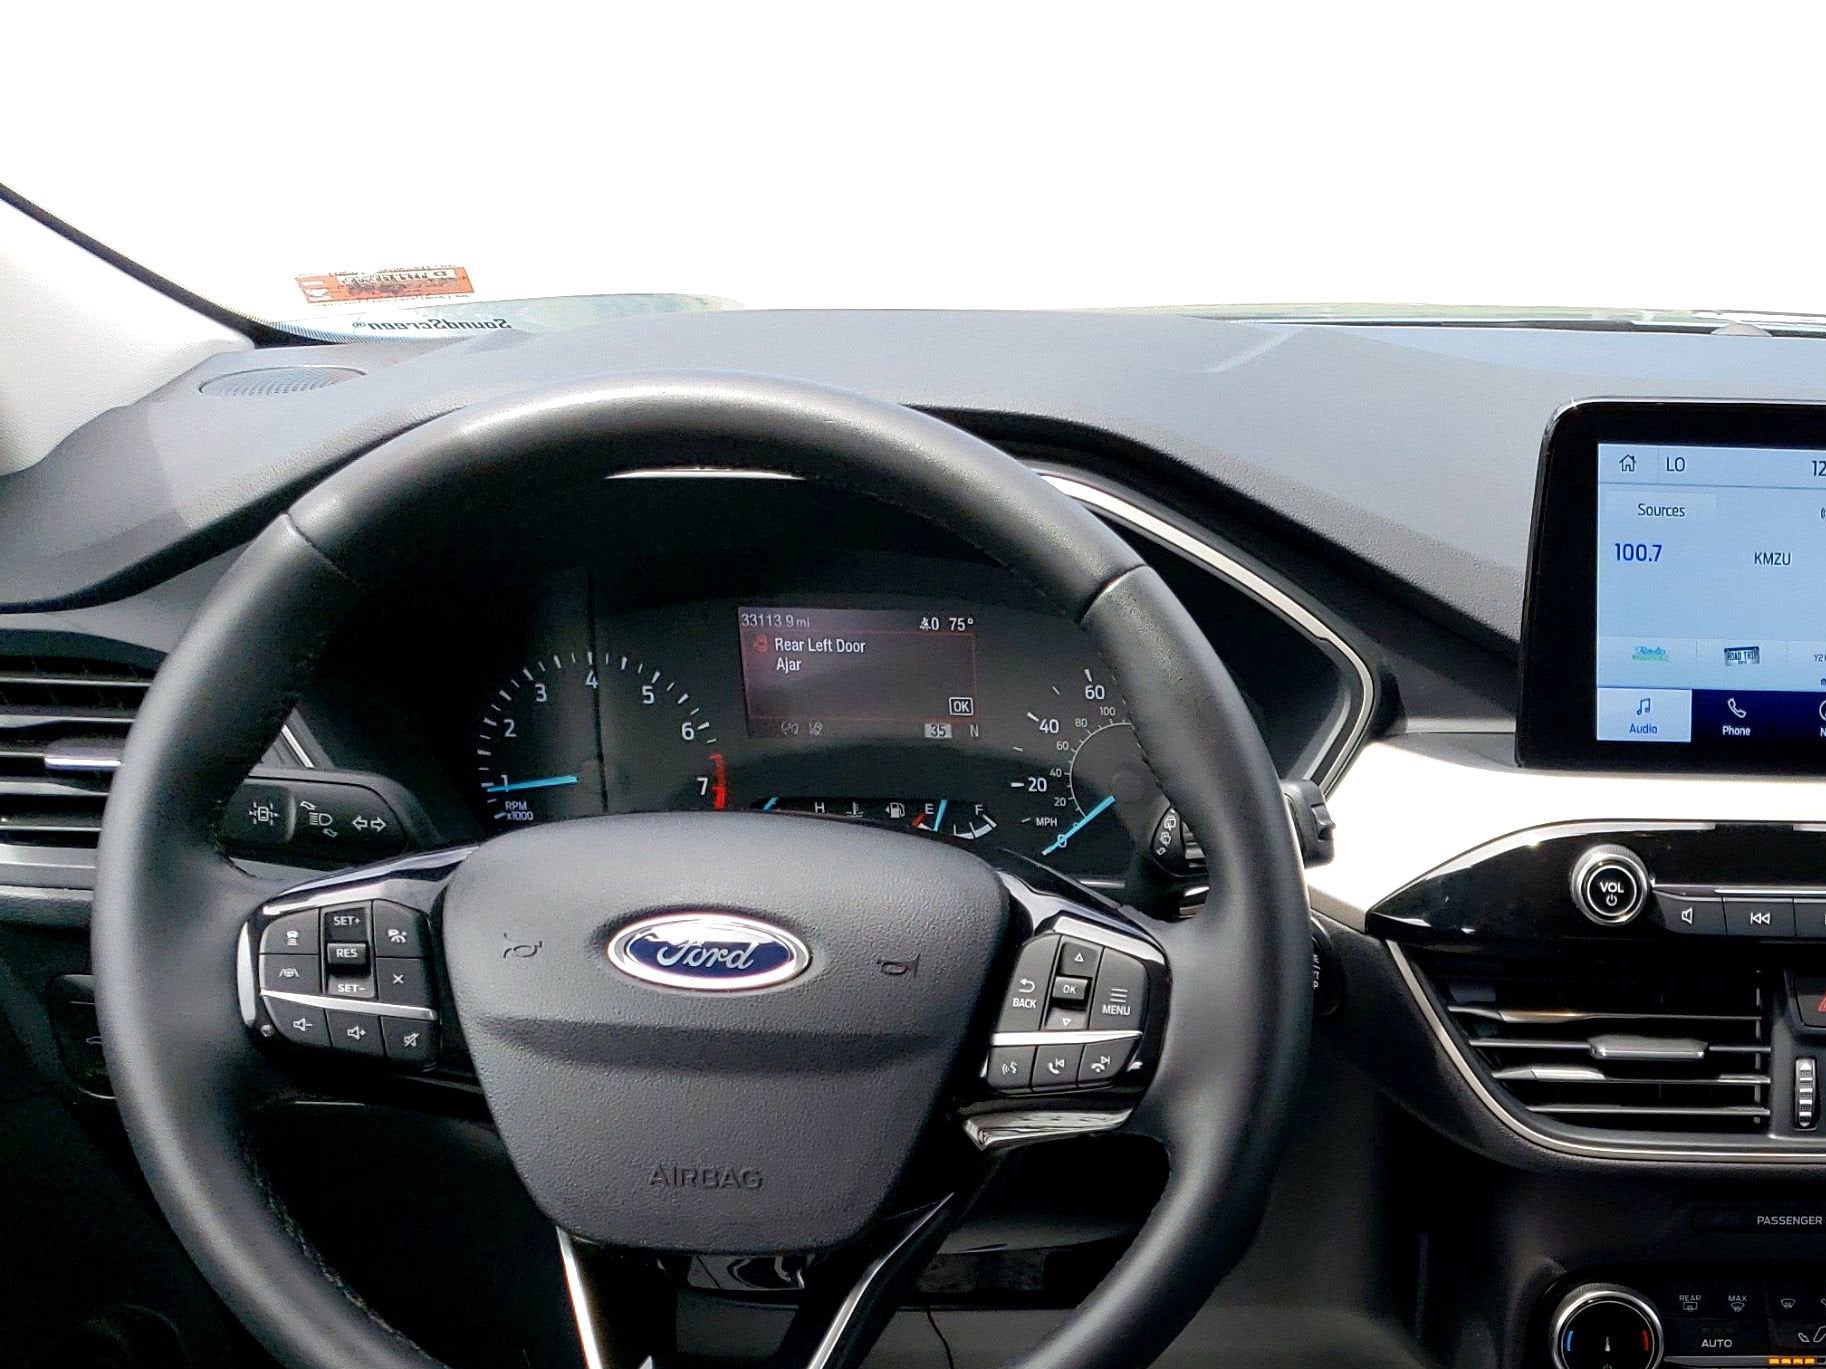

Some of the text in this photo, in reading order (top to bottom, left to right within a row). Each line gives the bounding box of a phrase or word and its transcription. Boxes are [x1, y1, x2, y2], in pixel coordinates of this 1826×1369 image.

[1666, 456, 1686, 472] LO
[1637, 503, 1686, 517] Sources
[1614, 543, 1663, 562] 100.7
[1754, 552, 1791, 566] KMZU
[796, 616, 811, 628] mi
[775, 637, 866, 653] Rear Left Door
[776, 656, 803, 674] Ajar
[585, 670, 598, 688] 4
[535, 683, 547, 702] 3
[641, 685, 655, 704] 5
[1085, 685, 1105, 700] 60
[953, 701, 970, 712] OK
[1100, 706, 1116, 716] 100
[503, 719, 517, 737] 2
[1039, 719, 1060, 734] 40
[1075, 718, 1088, 728] 80
[1629, 723, 1658, 734] Audio
[681, 722, 695, 740] 6
[929, 724, 947, 737] 35
[969, 724, 979, 737] N
[1722, 725, 1751, 736] Phone
[1056, 741, 1069, 751] 60
[1050, 768, 1062, 778] 40
[697, 777, 709, 795] 7
[1028, 777, 1047, 792] 20
[505, 800, 528, 811] RPM
[814, 802, 825, 814] H
[1054, 797, 1066, 807] 20
[924, 803, 934, 815] E
[974, 804, 984, 815] F
[1036, 817, 1058, 827] MPH
[1600, 881, 1625, 893] VOL
[333, 916, 361, 926] SET+
[336, 948, 358, 958] RES
[337, 984, 366, 993] SET-
[1062, 984, 1076, 994] OK
[1012, 998, 1037, 1009] BACK
[1102, 1005, 1131, 1016] MENU
[650, 1164, 764, 1190] AIRBAG
[1757, 1215, 1823, 1226] PASSENGER
[1679, 1294, 1701, 1302] REAR
[1727, 1294, 1748, 1302] MAX
[1701, 1339, 1733, 1349] AUTO
